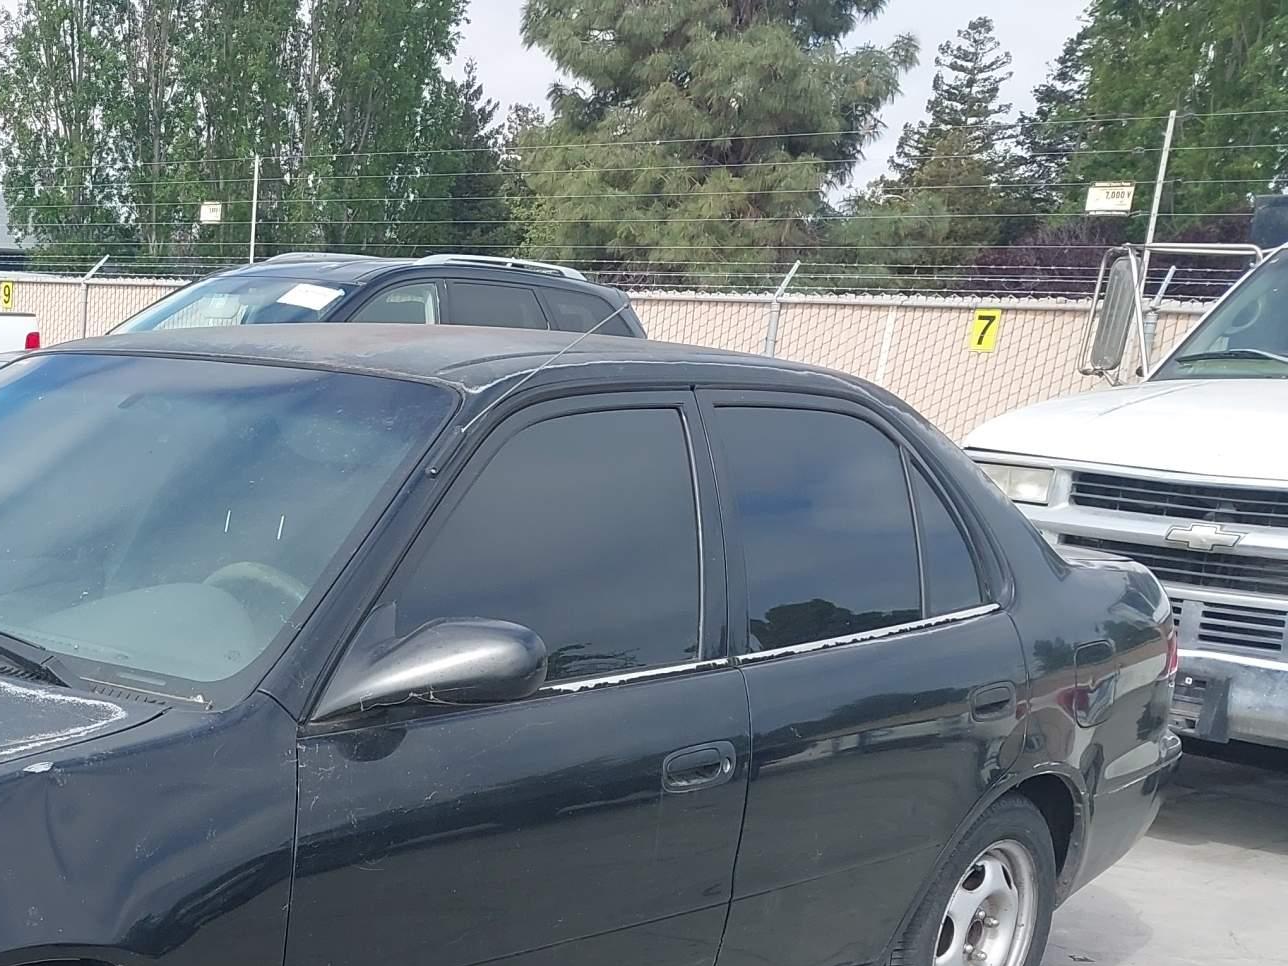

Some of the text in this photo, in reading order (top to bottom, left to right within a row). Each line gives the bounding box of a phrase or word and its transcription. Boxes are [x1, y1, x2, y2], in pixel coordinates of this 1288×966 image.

[1105, 191, 1125, 200] 7,000
[3, 284, 11, 304] 9
[976, 315, 997, 346] 7
